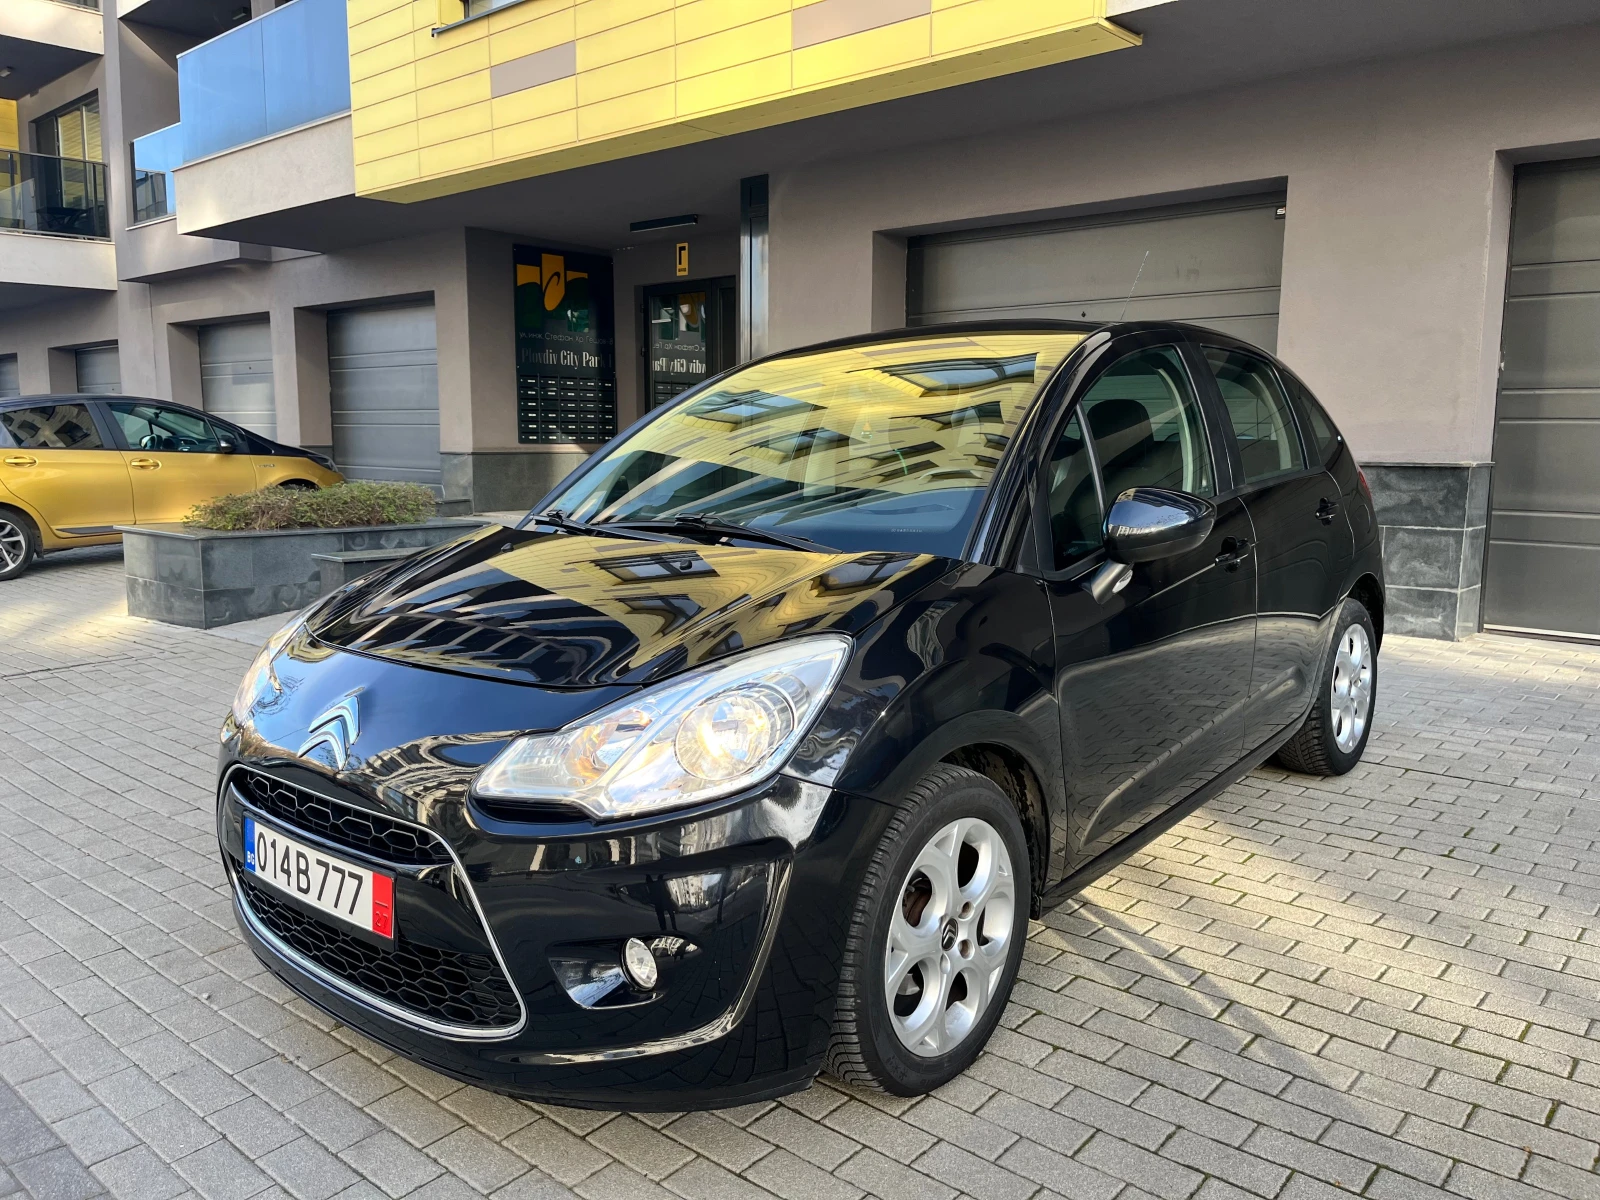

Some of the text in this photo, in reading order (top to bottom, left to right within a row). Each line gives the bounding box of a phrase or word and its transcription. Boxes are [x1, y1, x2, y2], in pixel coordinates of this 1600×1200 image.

[521, 348, 559, 365] Plovdiv
[560, 349, 580, 371] City
[582, 351, 606, 369] Park
[246, 850, 255, 866] BG
[257, 831, 364, 915] 014B777
